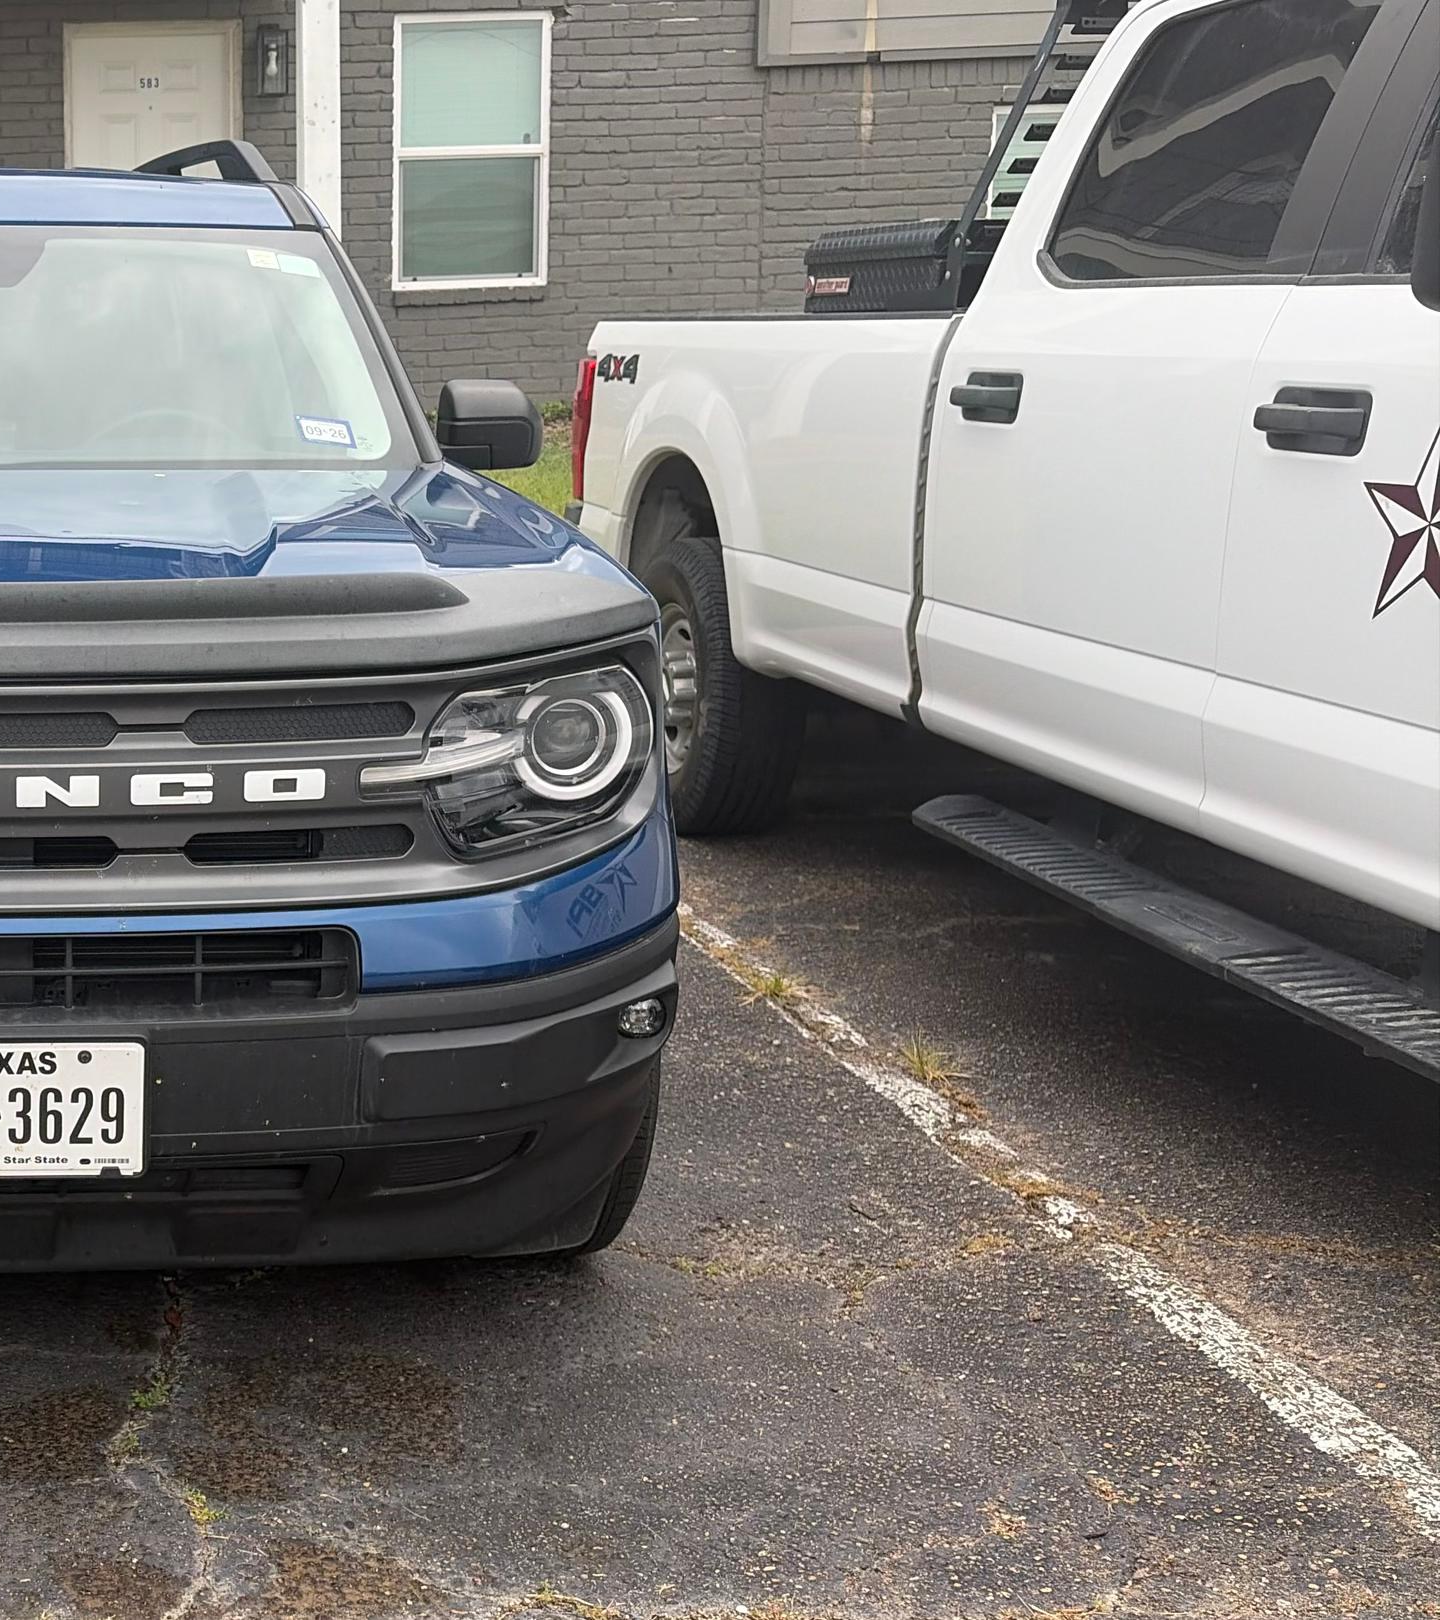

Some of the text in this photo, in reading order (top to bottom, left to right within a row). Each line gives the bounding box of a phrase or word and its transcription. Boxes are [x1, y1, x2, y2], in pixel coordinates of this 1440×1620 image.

[139, 77, 160, 89] 583
[305, 425, 347, 440] 09 26
[8, 1087, 125, 1145] 3629
[3, 1156, 31, 1164] Star
[34, 1155, 69, 1164] State
